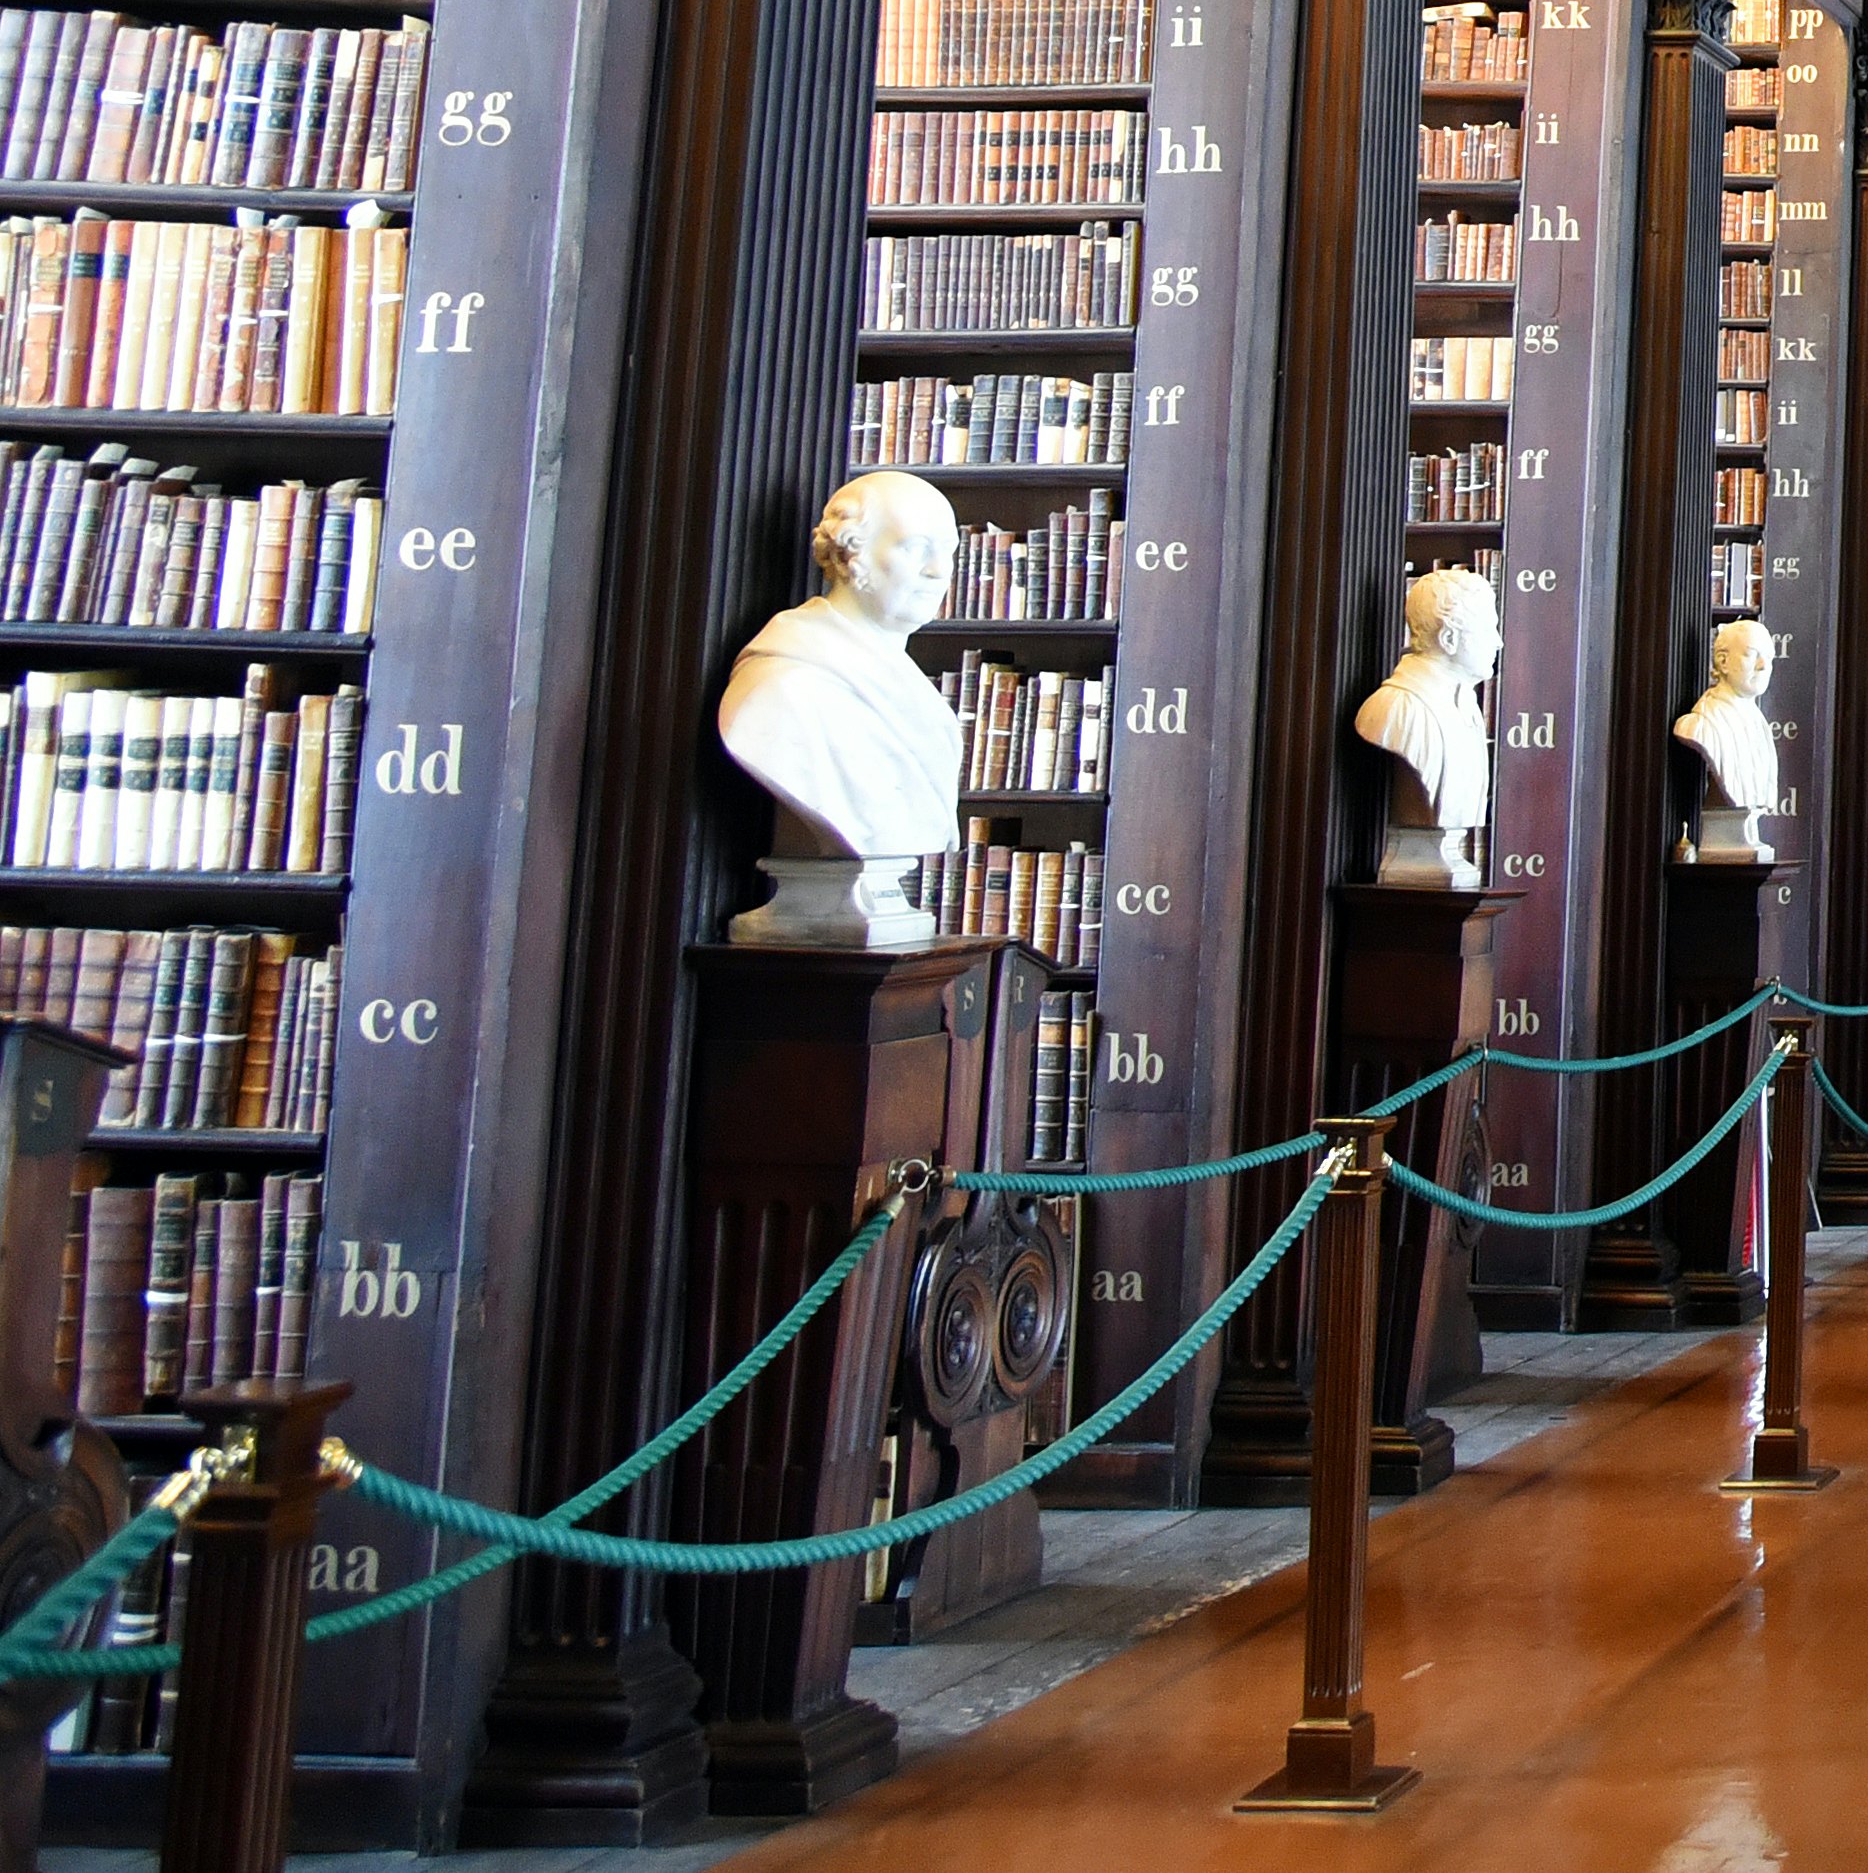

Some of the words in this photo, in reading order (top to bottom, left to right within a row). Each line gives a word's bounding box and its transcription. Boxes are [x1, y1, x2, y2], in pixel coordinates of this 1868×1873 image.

[1171, 6, 1203, 47] ii
[1542, 1, 1590, 29] kk
[1788, 10, 1823, 39] pp
[1787, 65, 1817, 83] oo
[439, 92, 512, 146] gg
[1536, 113, 1559, 143] ii
[1156, 126, 1222, 173] hh
[1784, 134, 1819, 152] nn
[1528, 205, 1580, 241] hh
[1780, 202, 1827, 220] mm
[1151, 267, 1198, 306] gg
[1780, 269, 1802, 296] ll
[415, 292, 484, 353] ff
[1524, 325, 1558, 353] gg
[1777, 338, 1816, 361] kk
[1144, 385, 1184, 425] ff
[1778, 400, 1797, 424] ii
[1518, 449, 1549, 479] ff
[1773, 469, 1809, 497] hh
[399, 528, 475, 570] ee
[1136, 541, 1187, 571] ee
[1517, 570, 1555, 592] ee
[1773, 558, 1799, 577] gg
[1127, 688, 1187, 733] dd
[1507, 712, 1554, 748] dd
[376, 724, 462, 794] dd
[1504, 854, 1544, 877] cc
[1117, 884, 1169, 914] cc
[963, 982, 976, 1012] S
[360, 999, 436, 1044] cc
[1496, 999, 1539, 1035] bb
[1106, 1033, 1163, 1083] bb
[1491, 1160, 1529, 1186] aa
[340, 1241, 420, 1317] bb
[1092, 1270, 1143, 1302] aa
[309, 1545, 378, 1592] aa
